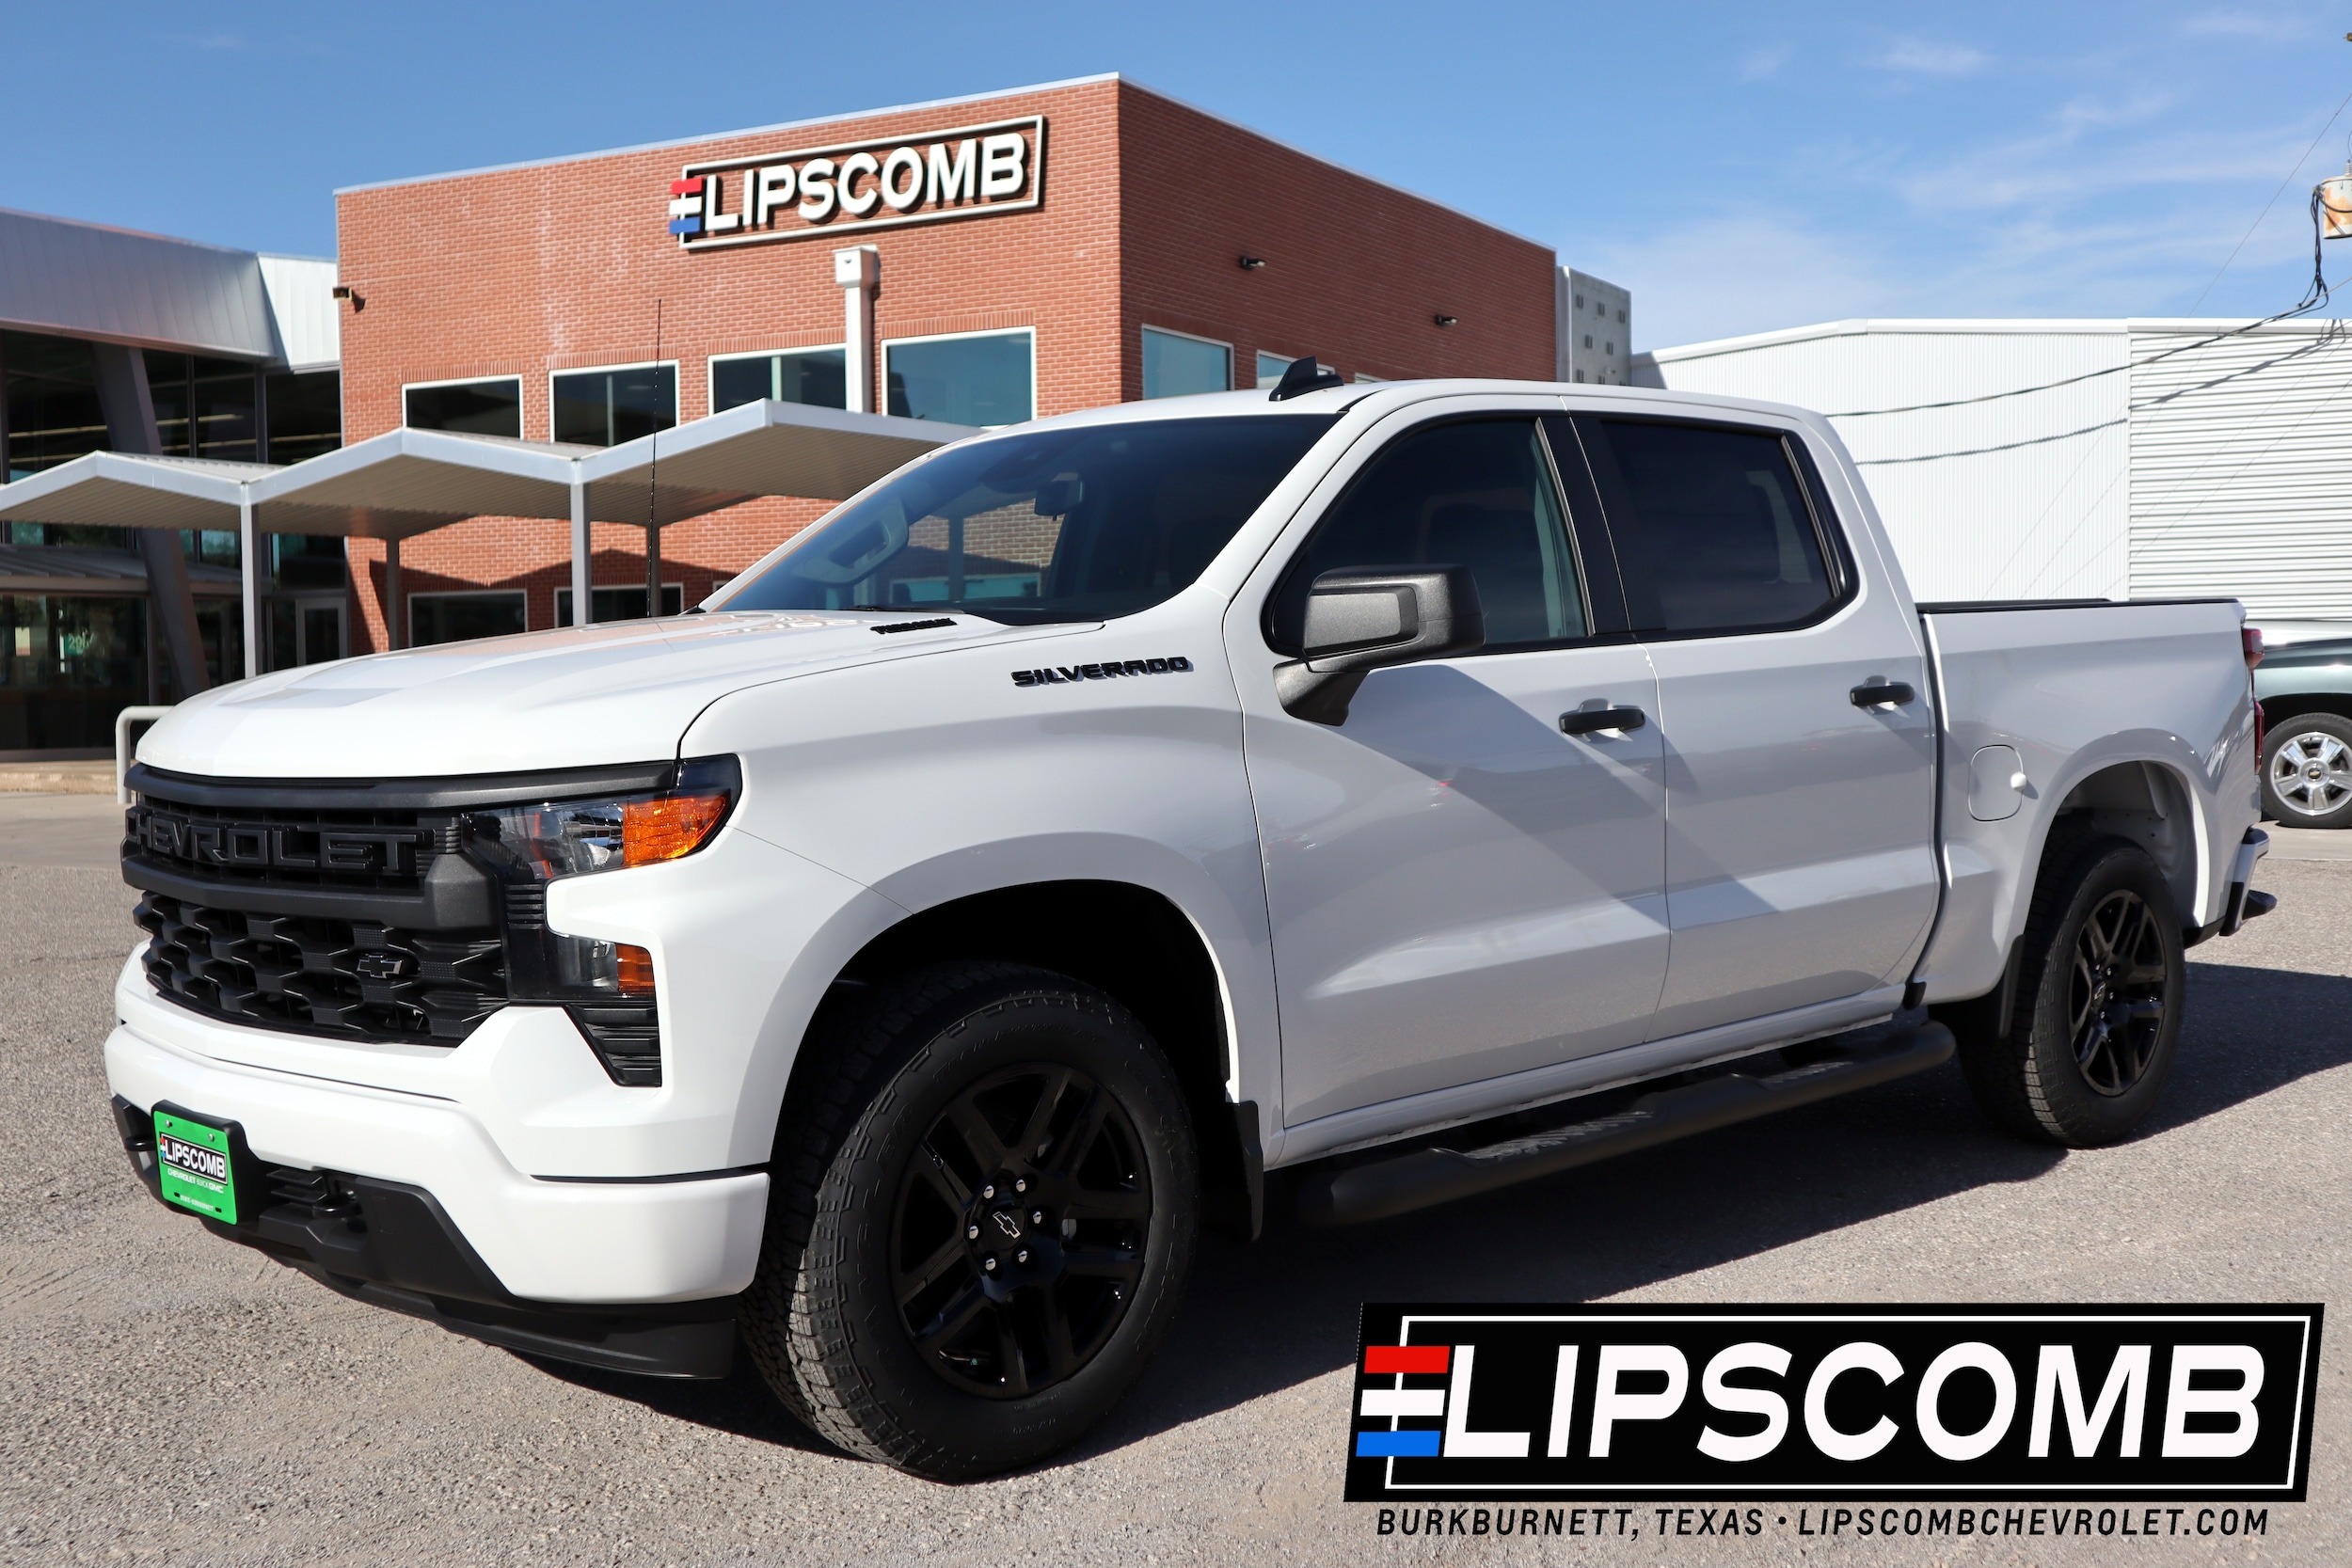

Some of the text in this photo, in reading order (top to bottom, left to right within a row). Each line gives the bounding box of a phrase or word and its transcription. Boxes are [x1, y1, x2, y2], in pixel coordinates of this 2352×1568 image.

[705, 132, 1026, 231] LIPSCOMB
[1010, 656, 1189, 686] SILVERADO
[125, 805, 421, 872] CHEVROLET
[165, 1138, 226, 1179] LIPSCOMB
